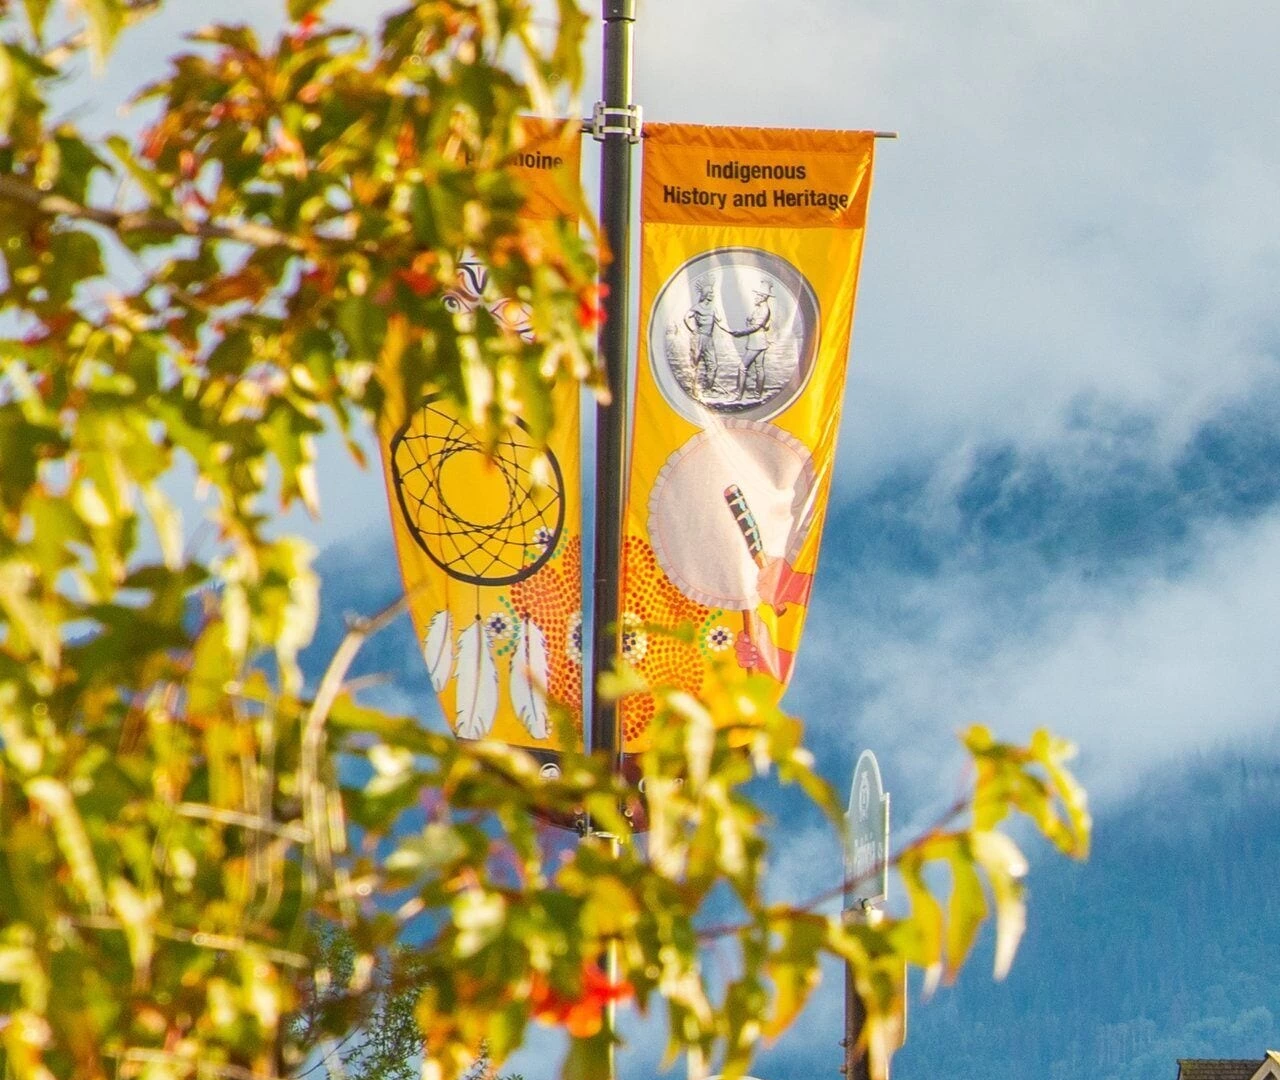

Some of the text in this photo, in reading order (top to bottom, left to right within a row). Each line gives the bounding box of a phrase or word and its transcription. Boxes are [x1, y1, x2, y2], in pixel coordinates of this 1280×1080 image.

[706, 159, 806, 183] Indigenous
[663, 185, 849, 211] History and Heritage
